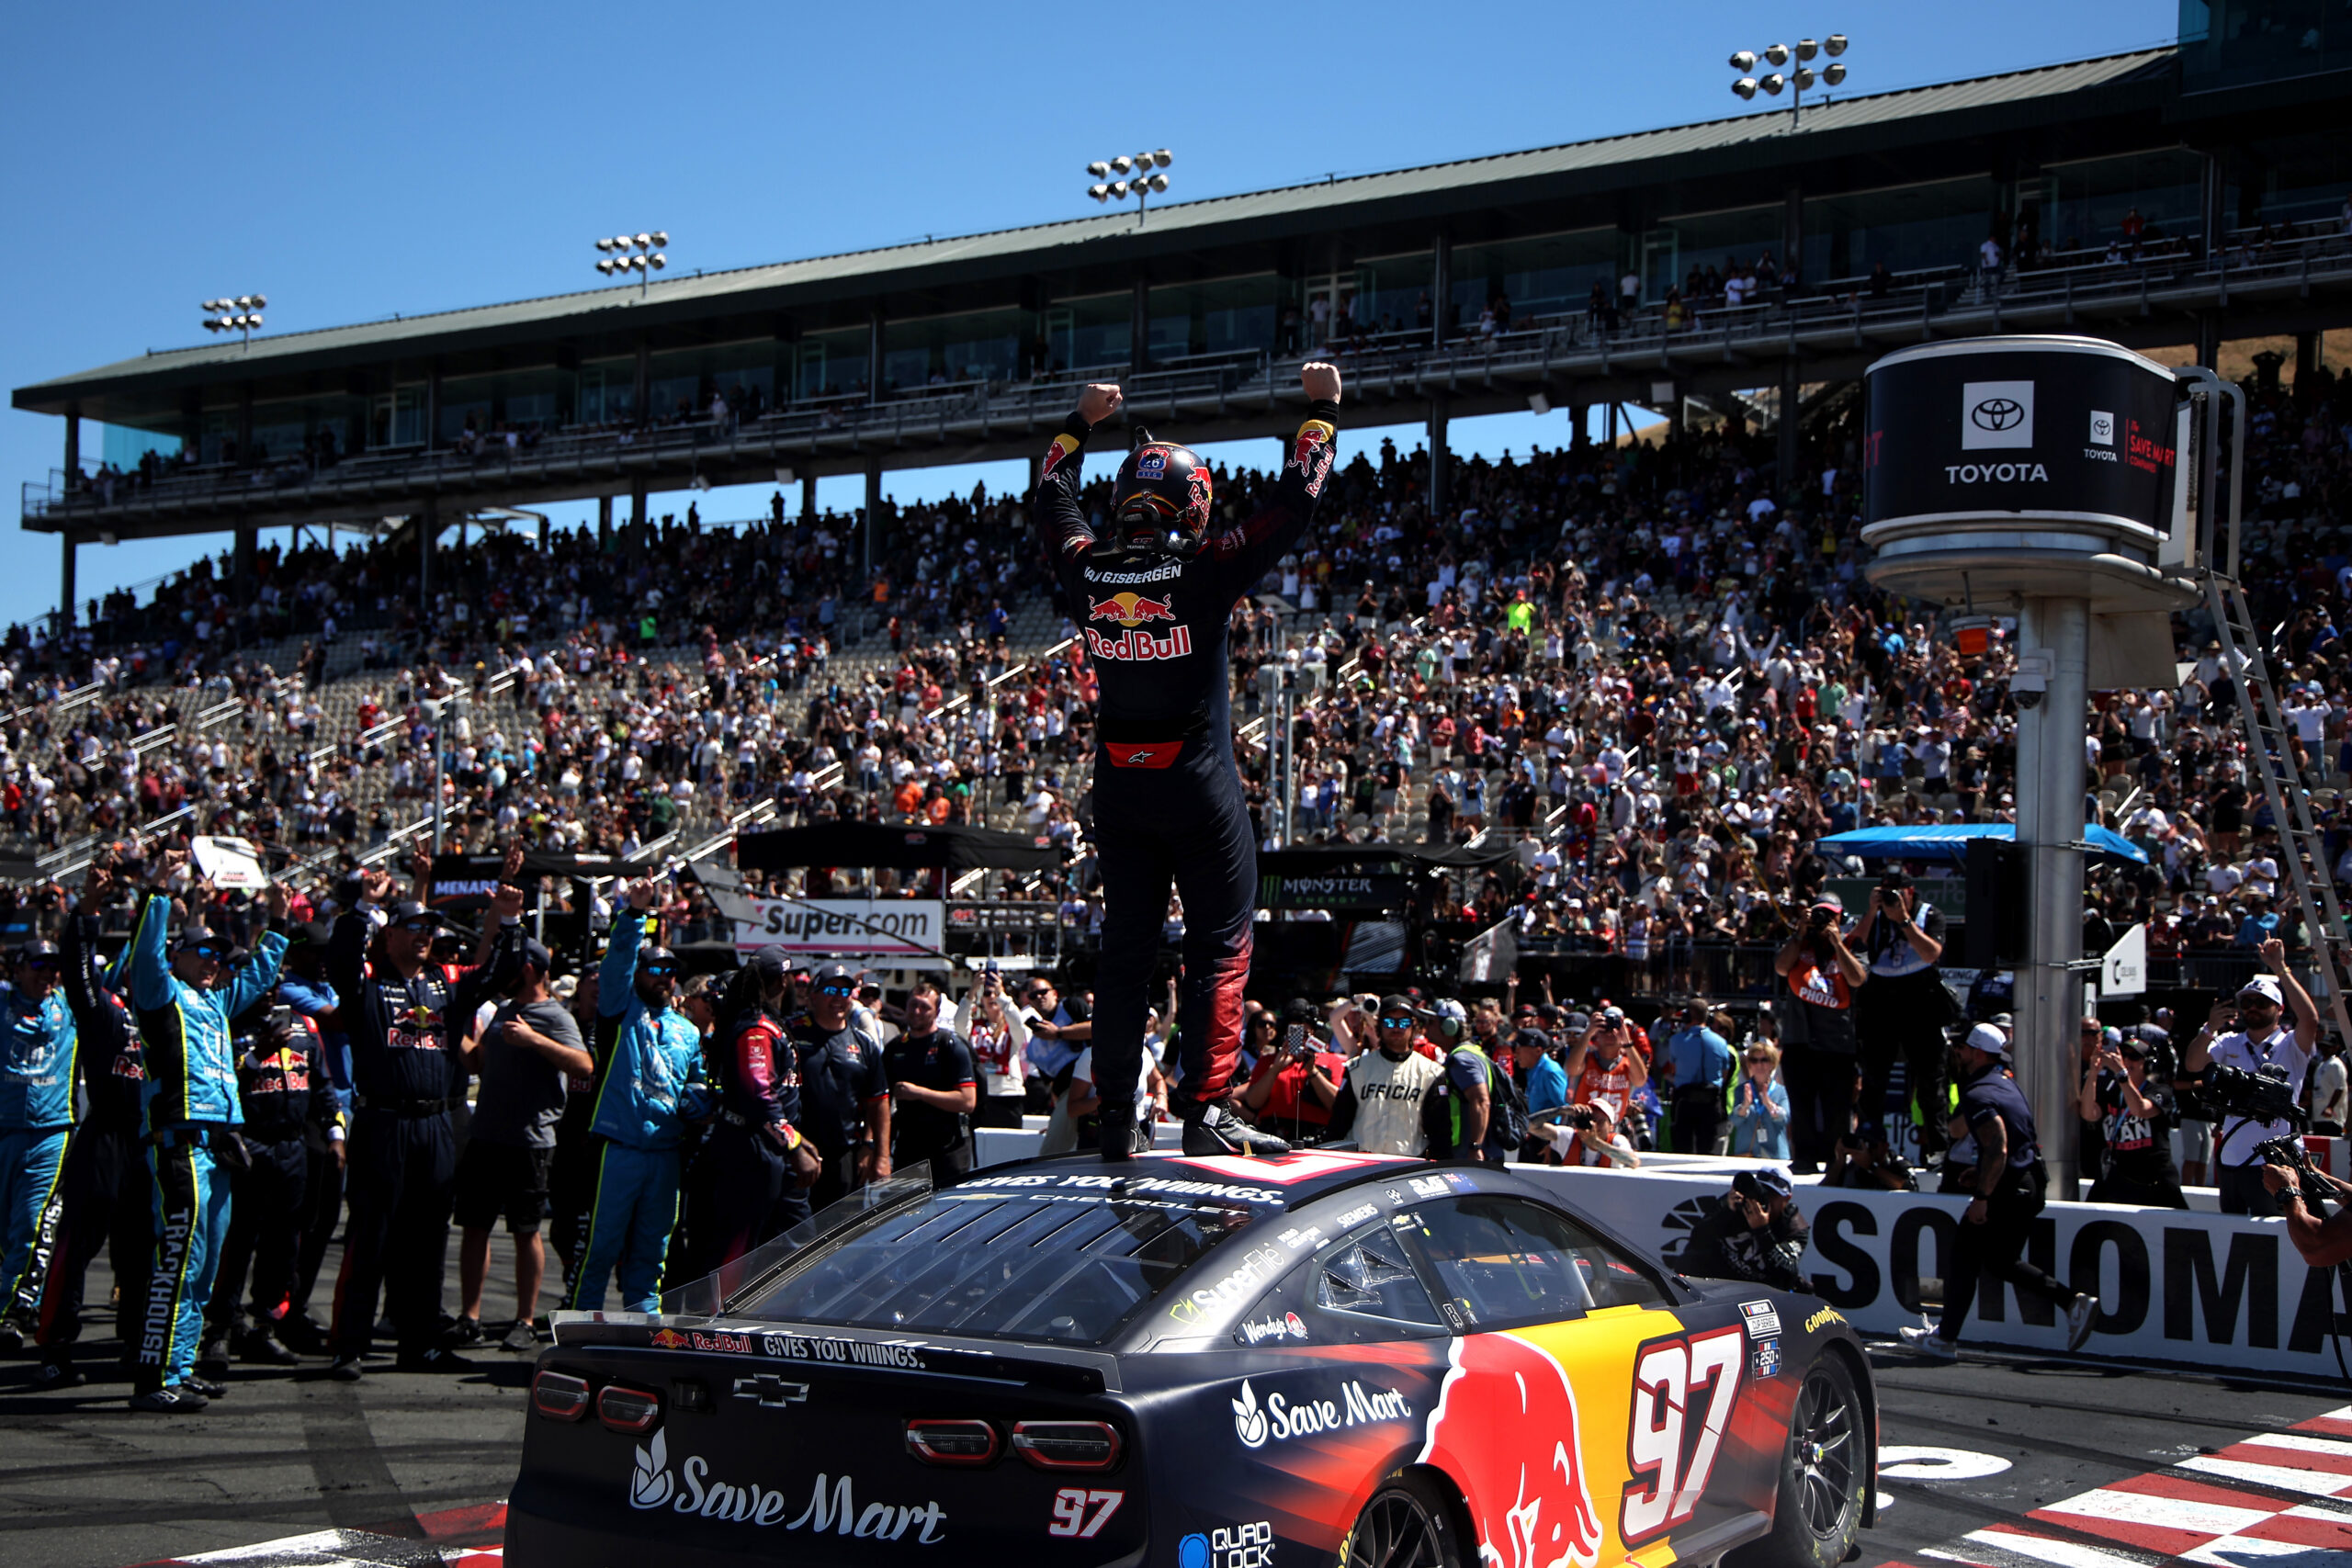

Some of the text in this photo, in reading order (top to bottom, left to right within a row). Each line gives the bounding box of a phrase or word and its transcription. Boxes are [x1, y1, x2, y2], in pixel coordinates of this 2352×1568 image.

[2084, 448, 2117, 462] TOYOTA
[2130, 434, 2153, 458] SAVE
[1945, 463, 2049, 484] TOYOTA
[1084, 564, 1182, 584] VAN GISBERGEN
[1283, 875, 1372, 894] MONSTER
[765, 905, 928, 941] Super.com
[1798, 987, 1839, 1009] PHOTO
[956, 1176, 1057, 1188] GIVES
[1029, 1195, 1249, 1216] CHEVROLET
[1337, 1202, 1378, 1228] SIEMENS
[140, 1206, 189, 1365] TRACKHOUSE
[1242, 1315, 1287, 1344] Wendy's
[763, 1336, 808, 1358] GIVES
[810, 1340, 847, 1362] YOU
[1760, 1350, 1775, 1366] 250
[1270, 1381, 1412, 1438] Save Mart
[1623, 1324, 1745, 1545] 97
[673, 1455, 947, 1545] Save Mart
[1048, 1488, 1125, 1539] 97
[1212, 1521, 1272, 1551] QUAD
